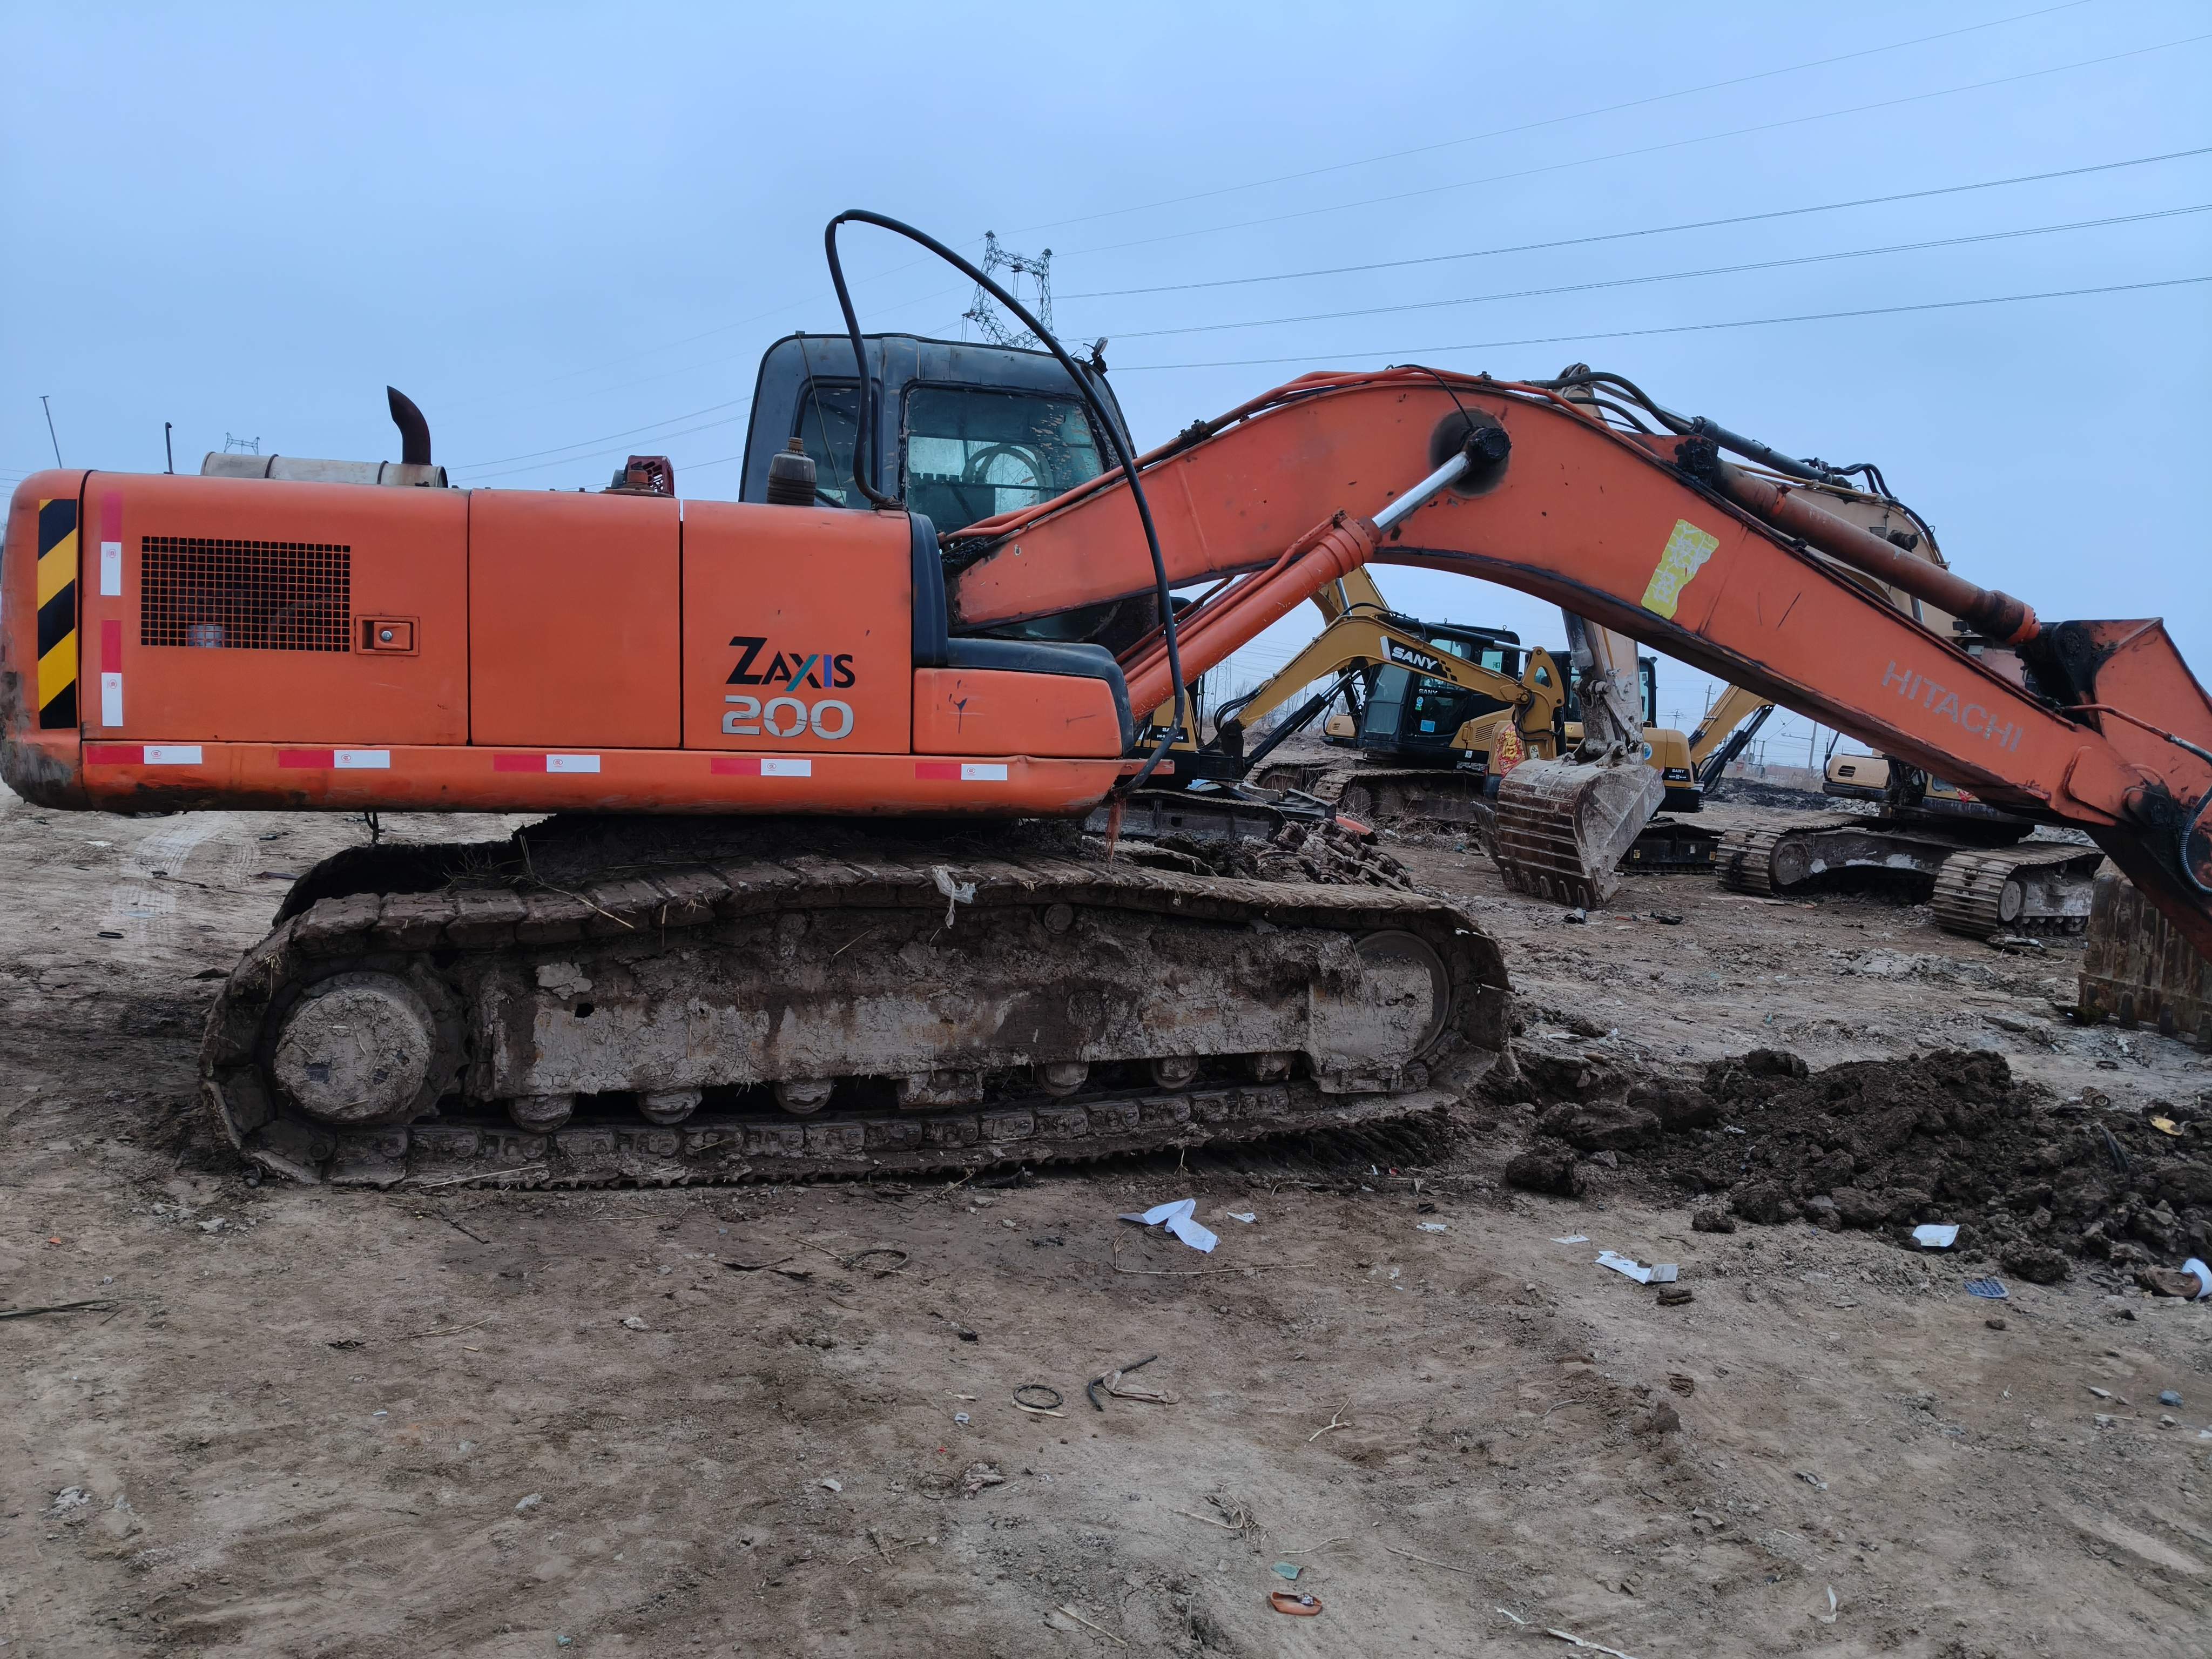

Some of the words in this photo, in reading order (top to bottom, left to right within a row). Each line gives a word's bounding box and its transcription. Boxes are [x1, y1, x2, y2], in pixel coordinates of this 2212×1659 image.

[725, 636, 855, 692] ZAXIS
[1392, 646, 1438, 670] SANY
[721, 694, 854, 740] 200
[1881, 660, 2024, 752] HITACHI
